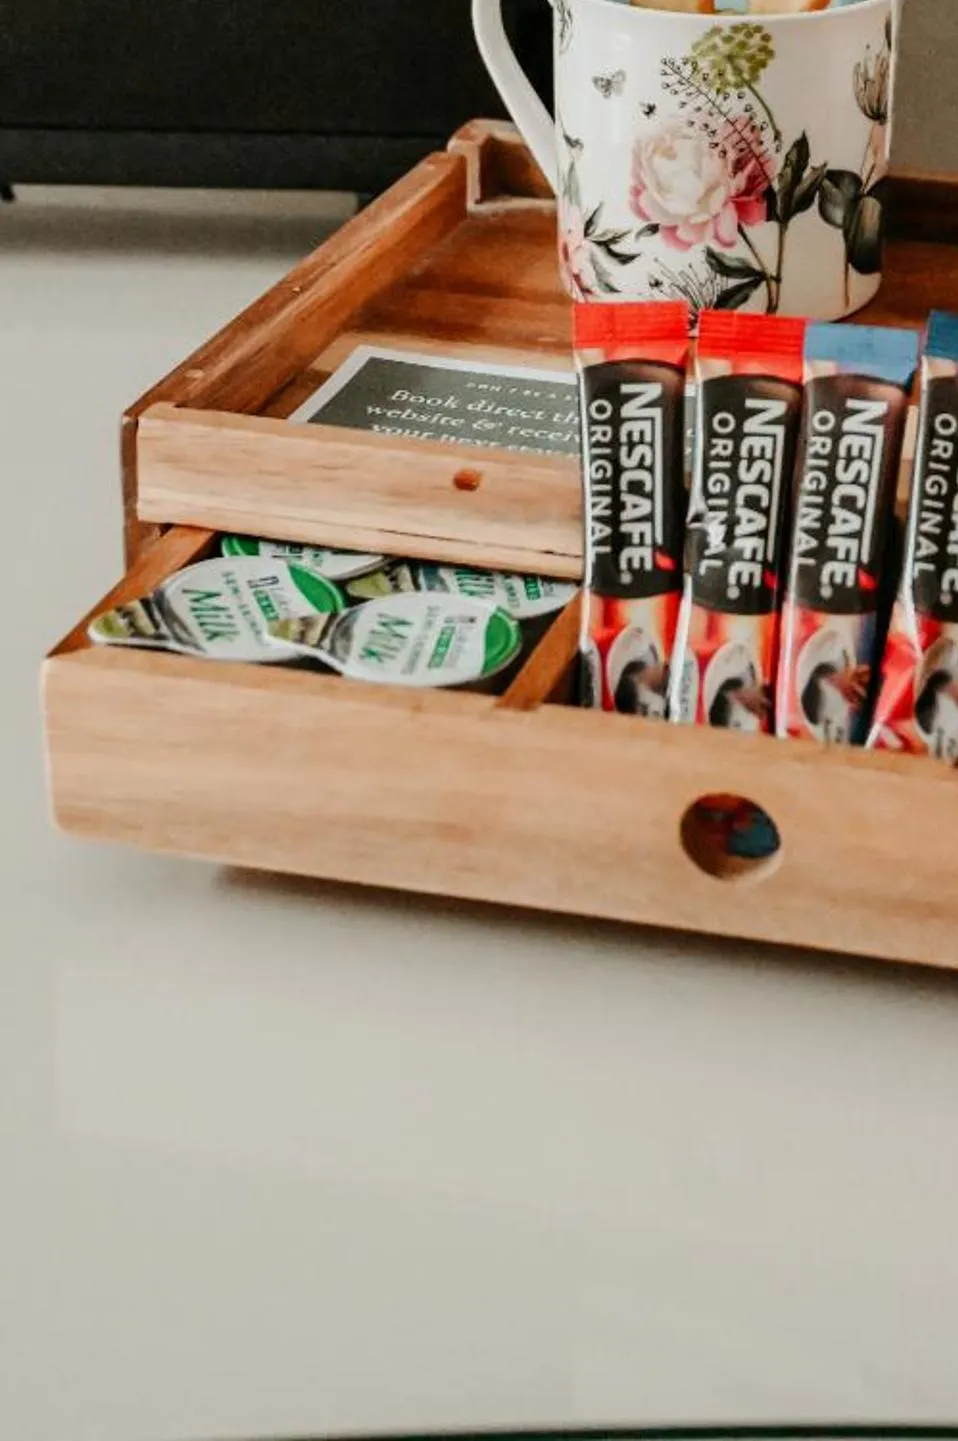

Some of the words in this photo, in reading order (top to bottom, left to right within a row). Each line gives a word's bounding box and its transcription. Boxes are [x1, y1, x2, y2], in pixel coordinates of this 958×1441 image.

[366, 405, 465, 428] website
[391, 389, 458, 409] Book
[468, 399, 546, 422] direct
[588, 398, 613, 564] ORIGINAL
[699, 412, 736, 576] ORIGINAL
[913, 413, 958, 580] ORIGINAL
[181, 588, 241, 642] Milk
